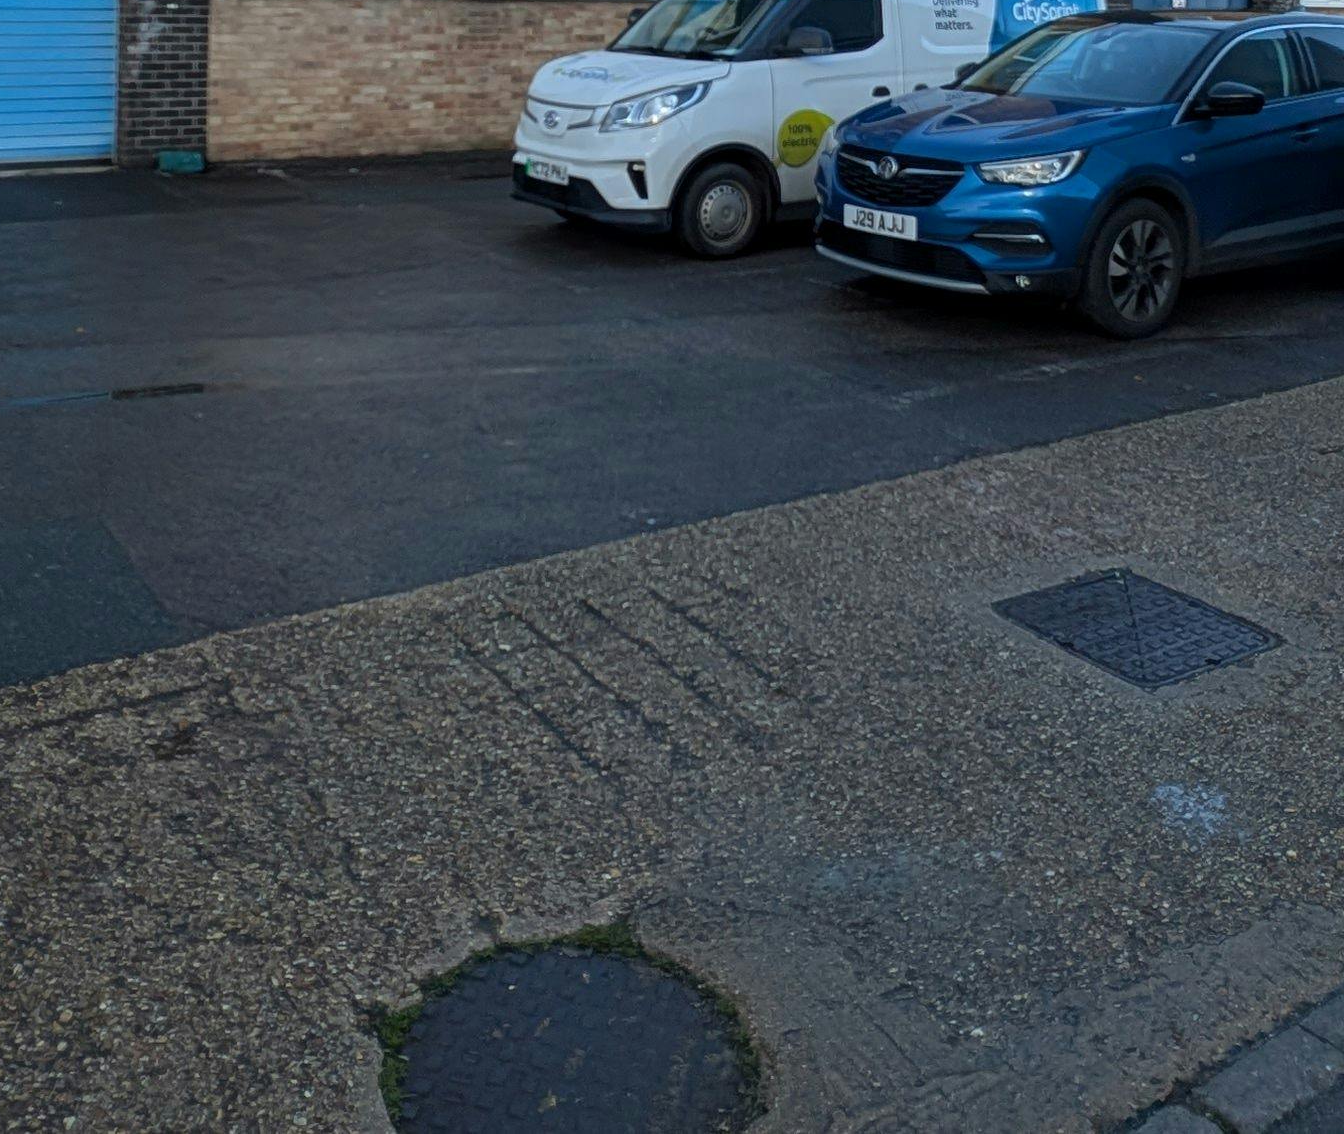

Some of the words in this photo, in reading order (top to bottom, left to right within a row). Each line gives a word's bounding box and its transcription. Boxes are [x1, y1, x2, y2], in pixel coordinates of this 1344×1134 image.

[934, 10, 957, 18] what
[852, 209, 875, 229] J29
[878, 213, 905, 234] AJJ
